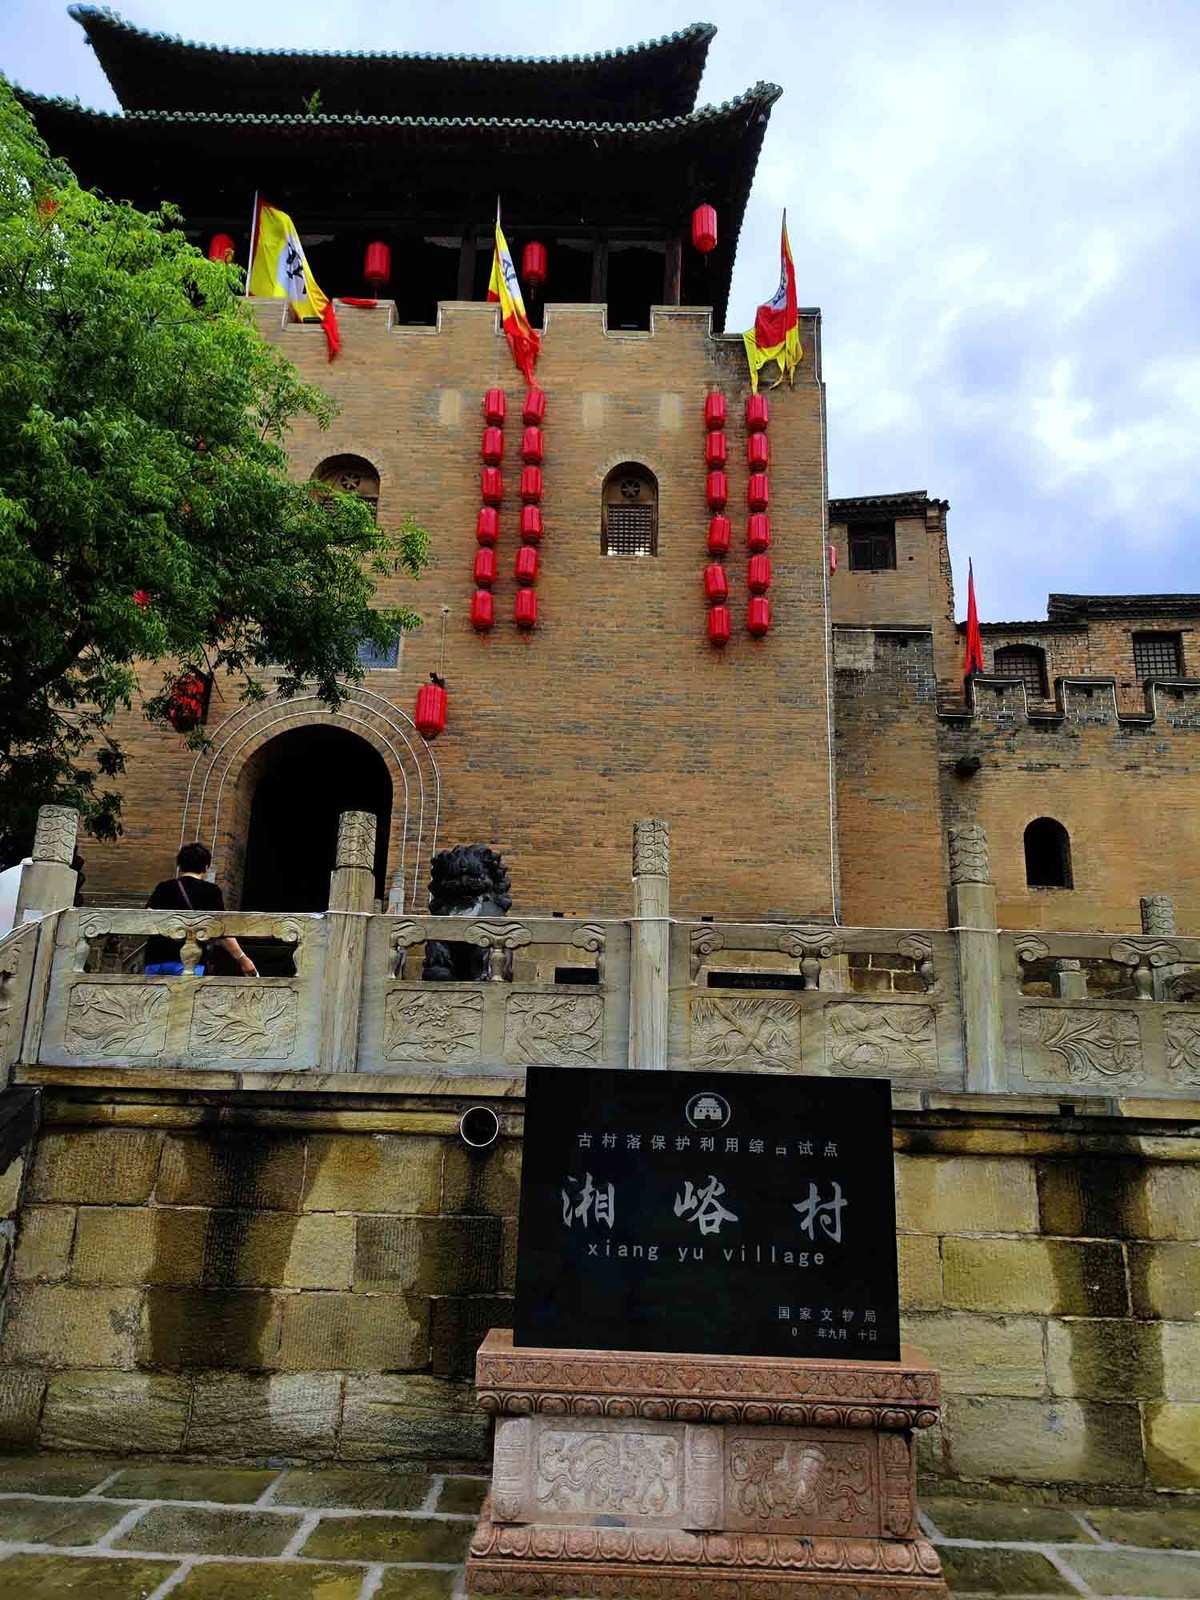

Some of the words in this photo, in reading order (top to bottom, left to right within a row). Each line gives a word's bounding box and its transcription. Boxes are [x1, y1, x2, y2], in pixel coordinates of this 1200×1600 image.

[561, 1171, 848, 1243] 湘峪村
[588, 1239, 659, 1261] xiang
[678, 1245, 704, 1262] yu
[723, 1244, 825, 1267] village
[778, 1305, 877, 1323] 国家文物局
